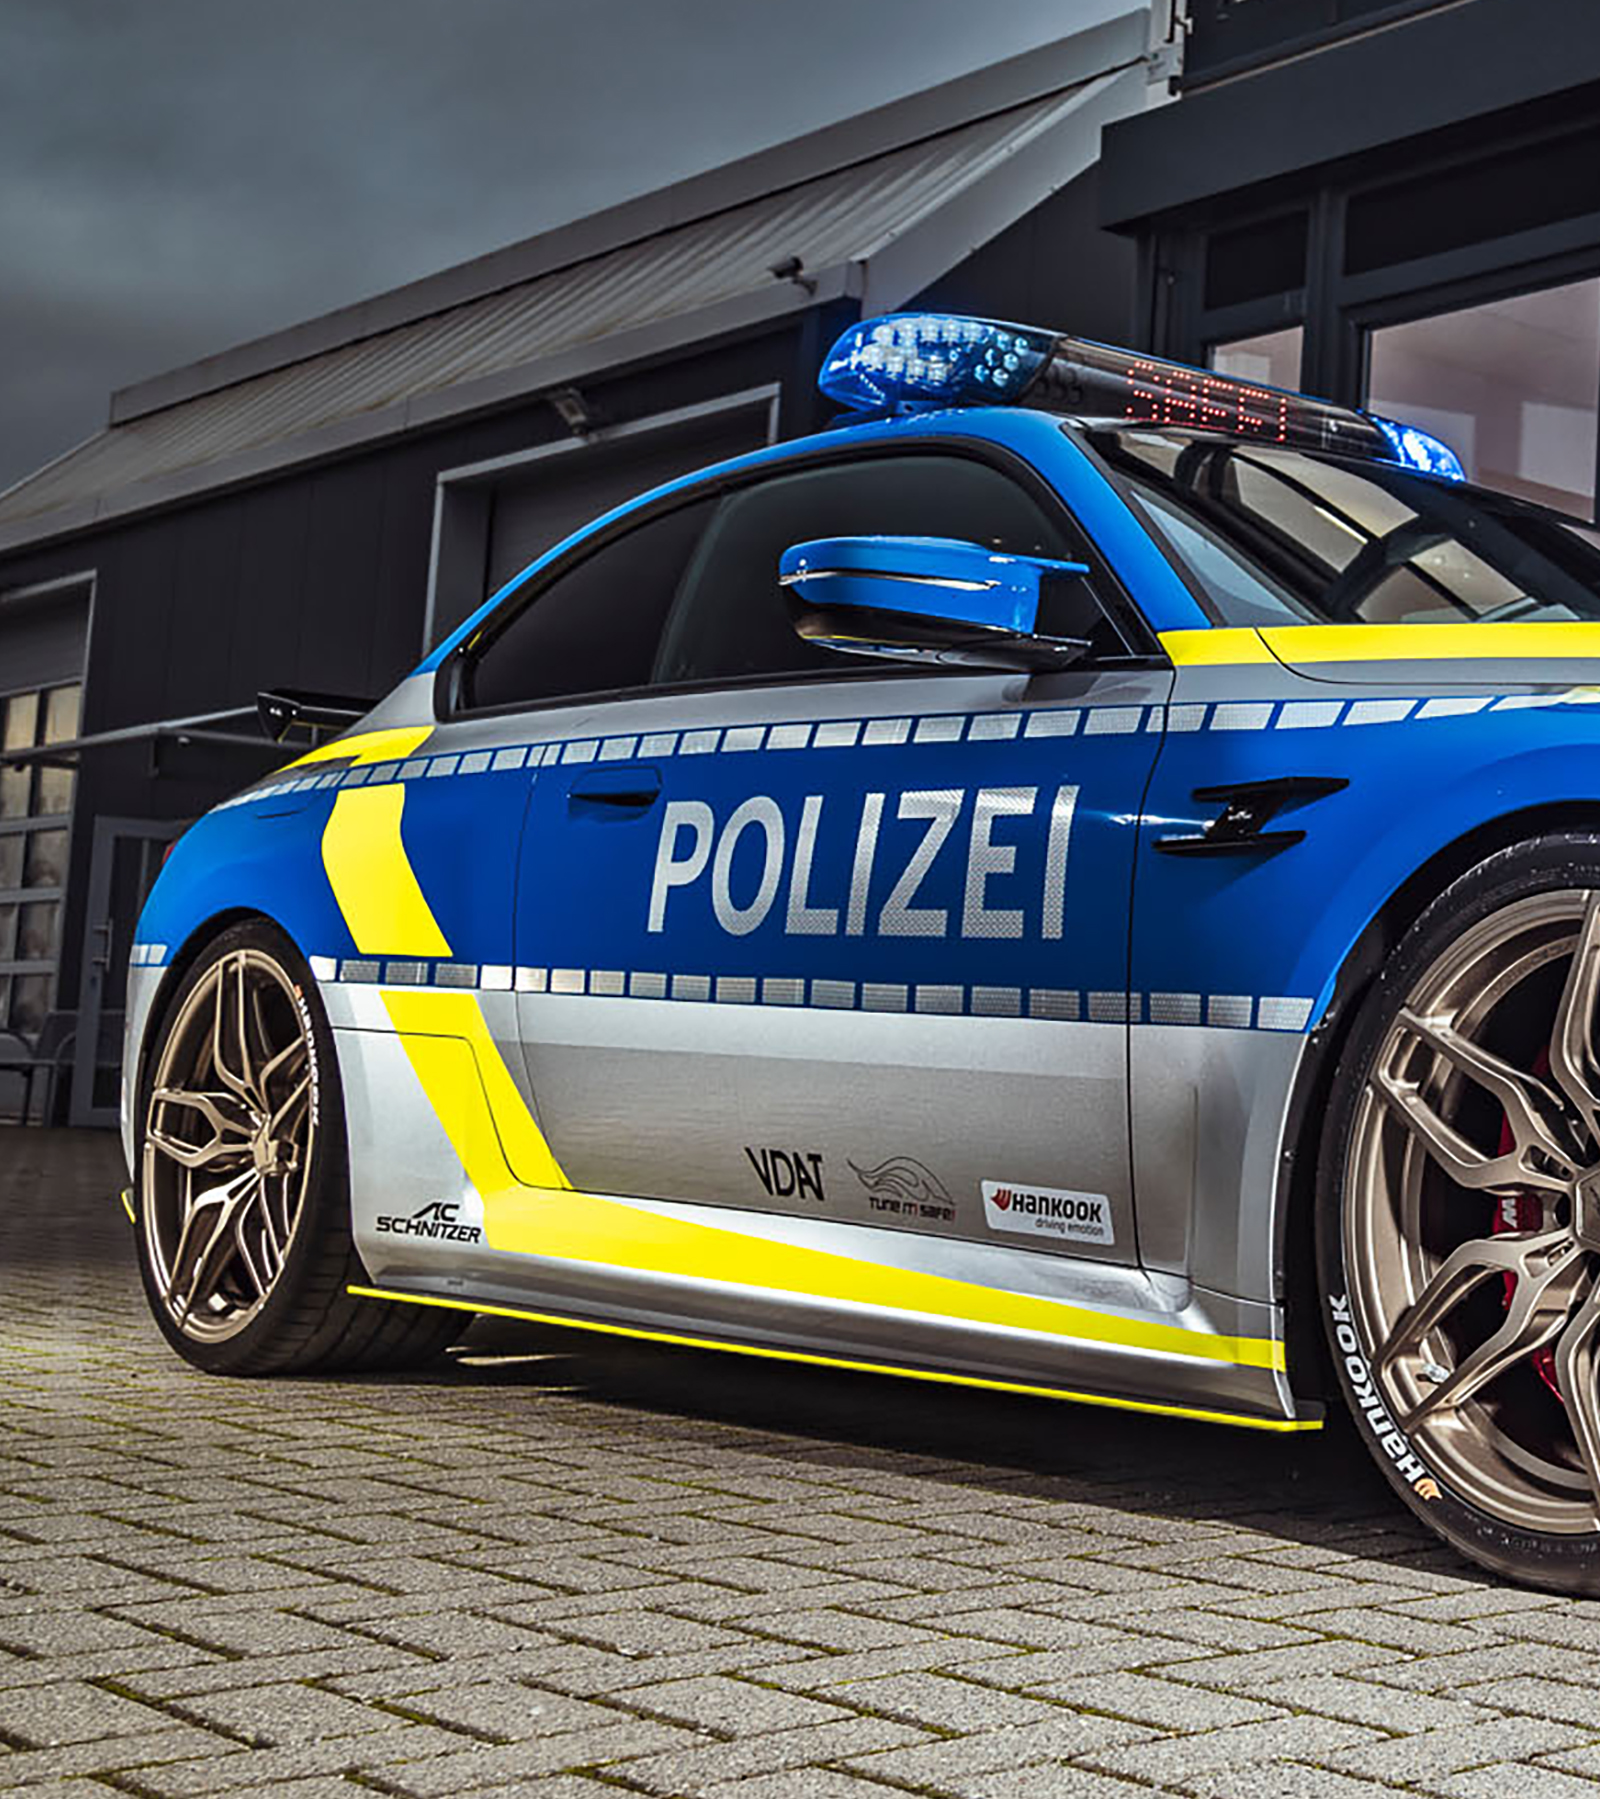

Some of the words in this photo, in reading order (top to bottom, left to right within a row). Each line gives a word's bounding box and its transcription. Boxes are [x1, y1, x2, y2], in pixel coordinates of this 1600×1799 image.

[647, 784, 1080, 940] POLIZEI
[744, 1146, 825, 1202] VDAT
[375, 1216, 481, 1244] SCHNITZER
[411, 1201, 460, 1222] AC
